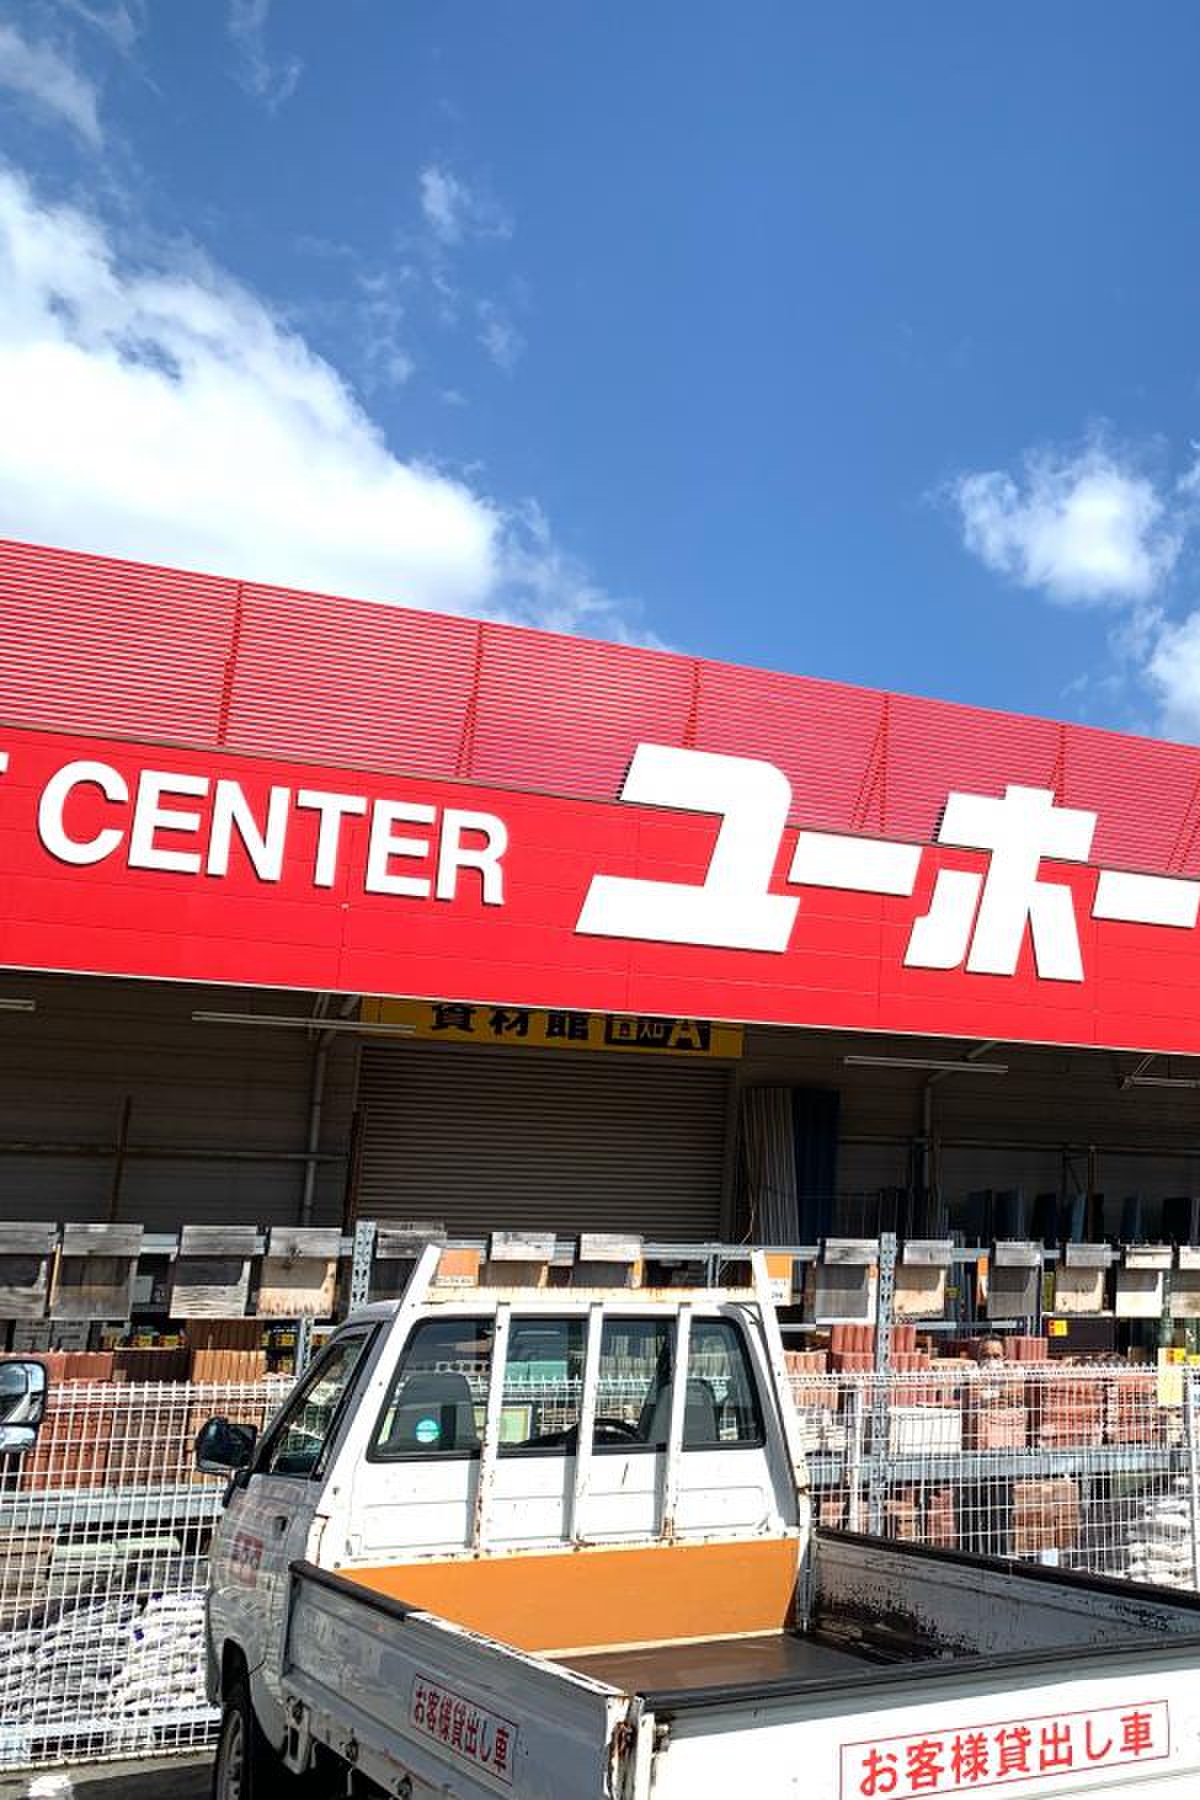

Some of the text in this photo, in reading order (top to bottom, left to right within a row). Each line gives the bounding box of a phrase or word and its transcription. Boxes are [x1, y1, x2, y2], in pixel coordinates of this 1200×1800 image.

[37, 760, 508, 905] CENTER
[414, 1685, 510, 1770] お客様貸出し車
[859, 1710, 1154, 1797] お客様貸出し車
